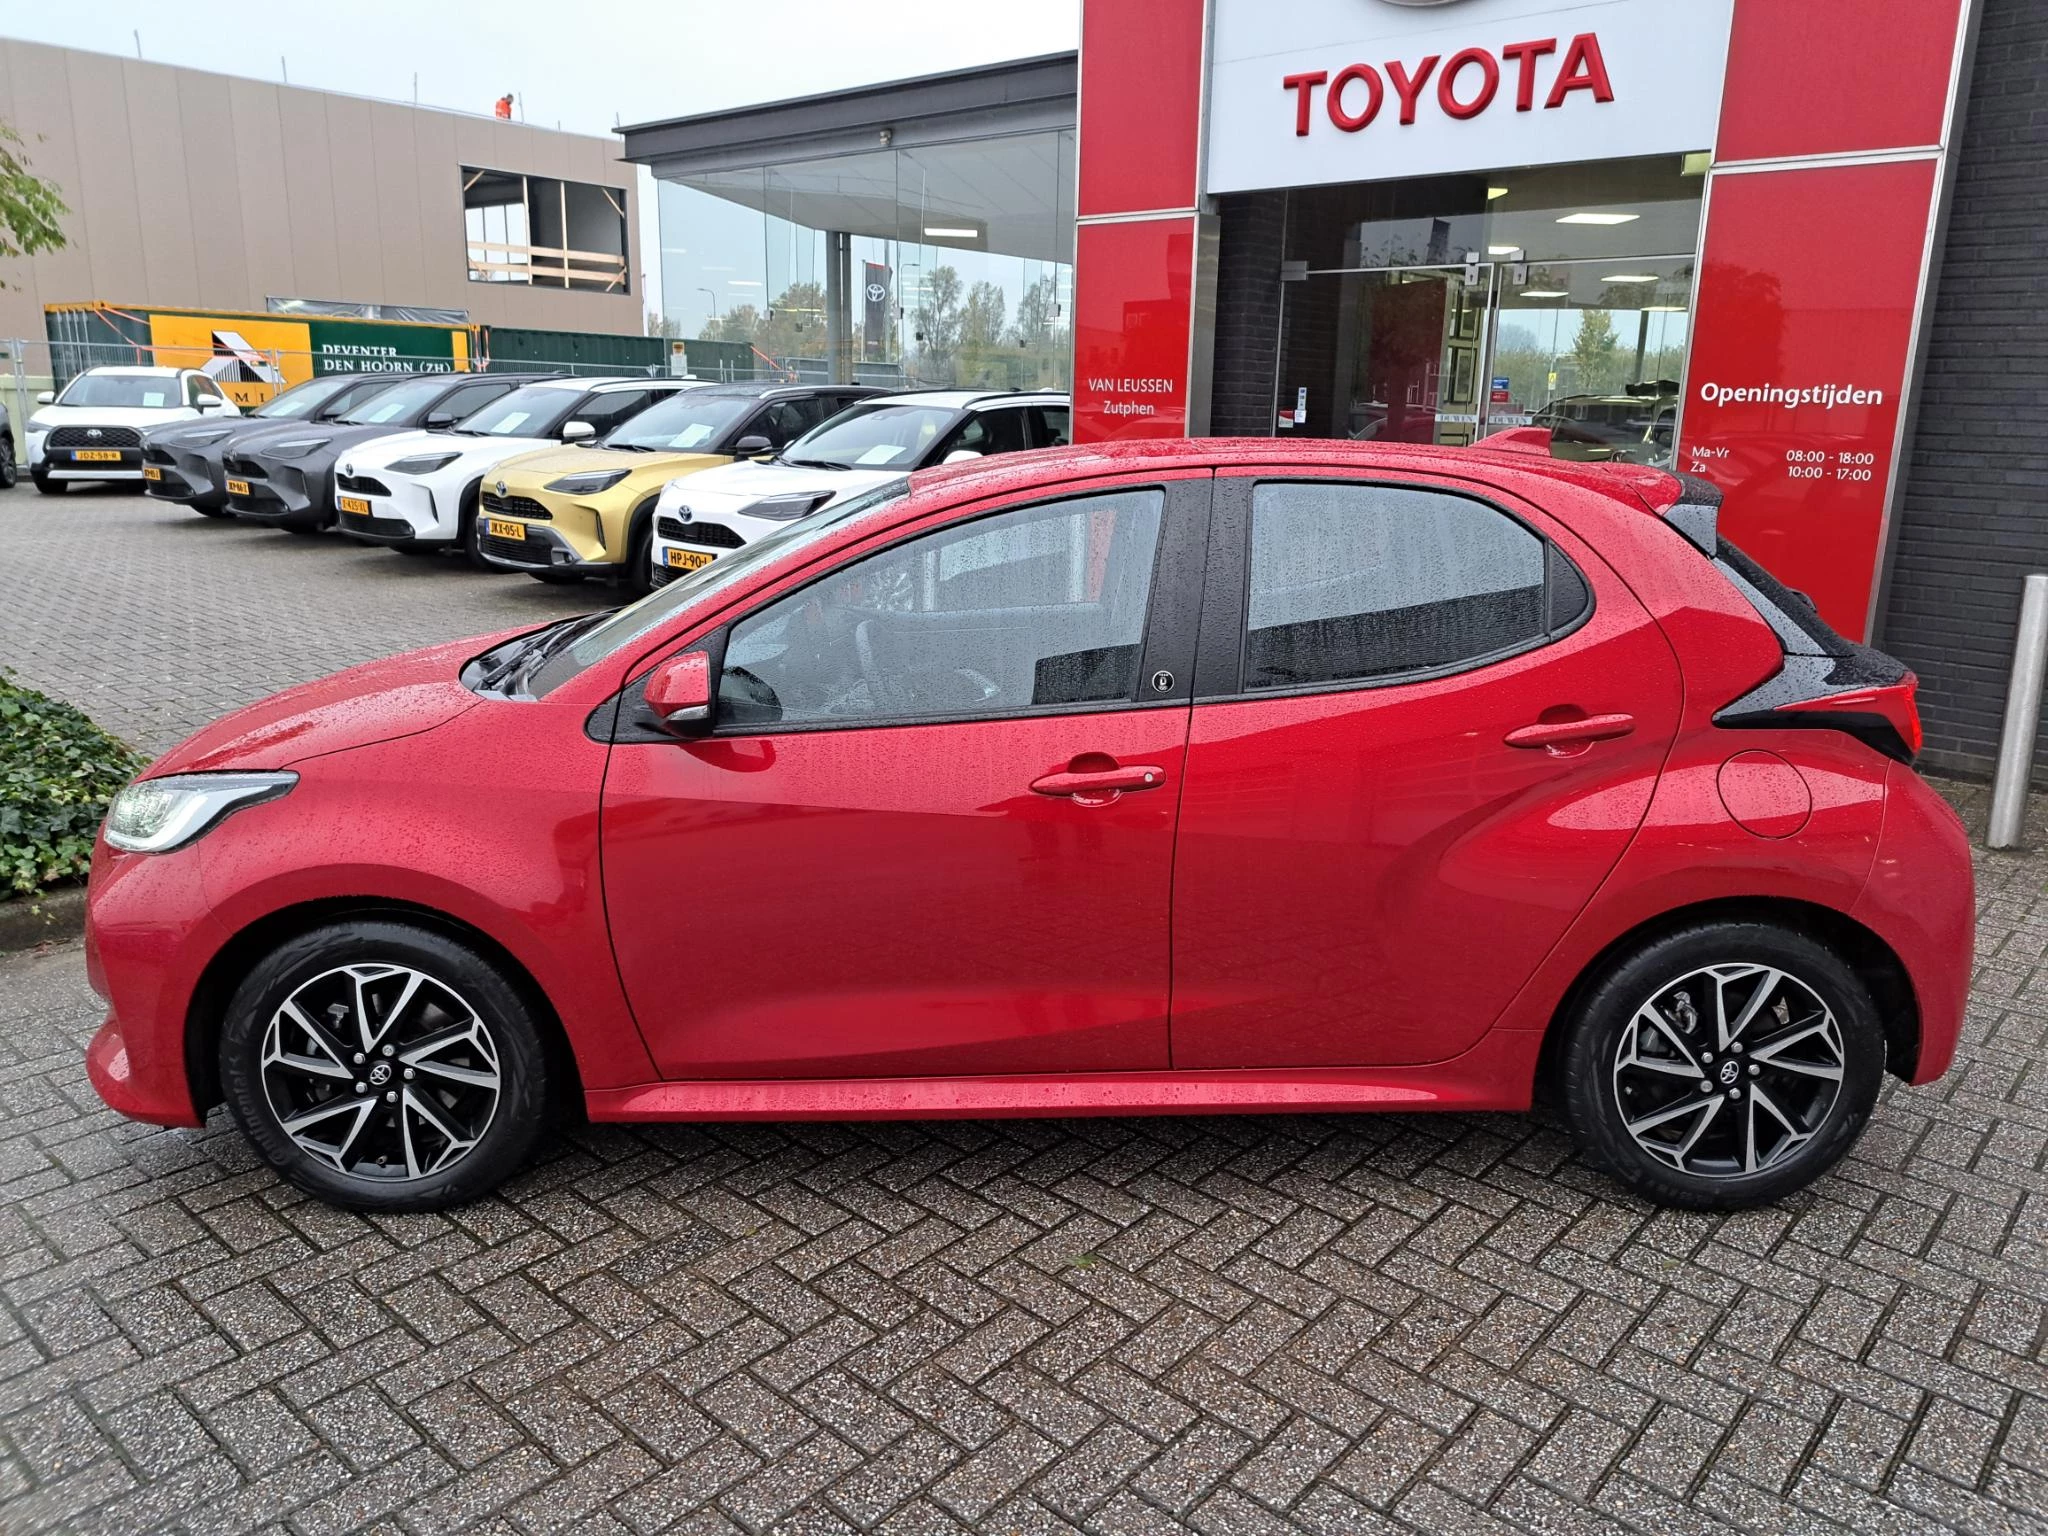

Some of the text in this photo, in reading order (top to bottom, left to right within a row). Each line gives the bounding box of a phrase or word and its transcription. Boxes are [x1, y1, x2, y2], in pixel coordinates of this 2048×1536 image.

[1283, 32, 1615, 136] TOYOTA
[322, 344, 397, 357] DEVENTER
[323, 359, 451, 373] DEN HOORN (ZH)
[1088, 378, 1173, 392] VAN LEUSSEN
[1701, 382, 1883, 409] Openingstijden
[1103, 400, 1154, 418] Zutphen
[1691, 446, 1730, 459] Ma-Vr
[1786, 450, 1825, 463] 08:00
[1838, 452, 1874, 465] 18:00
[1690, 461, 1706, 473] Za
[1788, 466, 1823, 479] 10:00
[1836, 468, 1872, 481] 17:00
[491, 521, 523, 538] JKX-05-L
